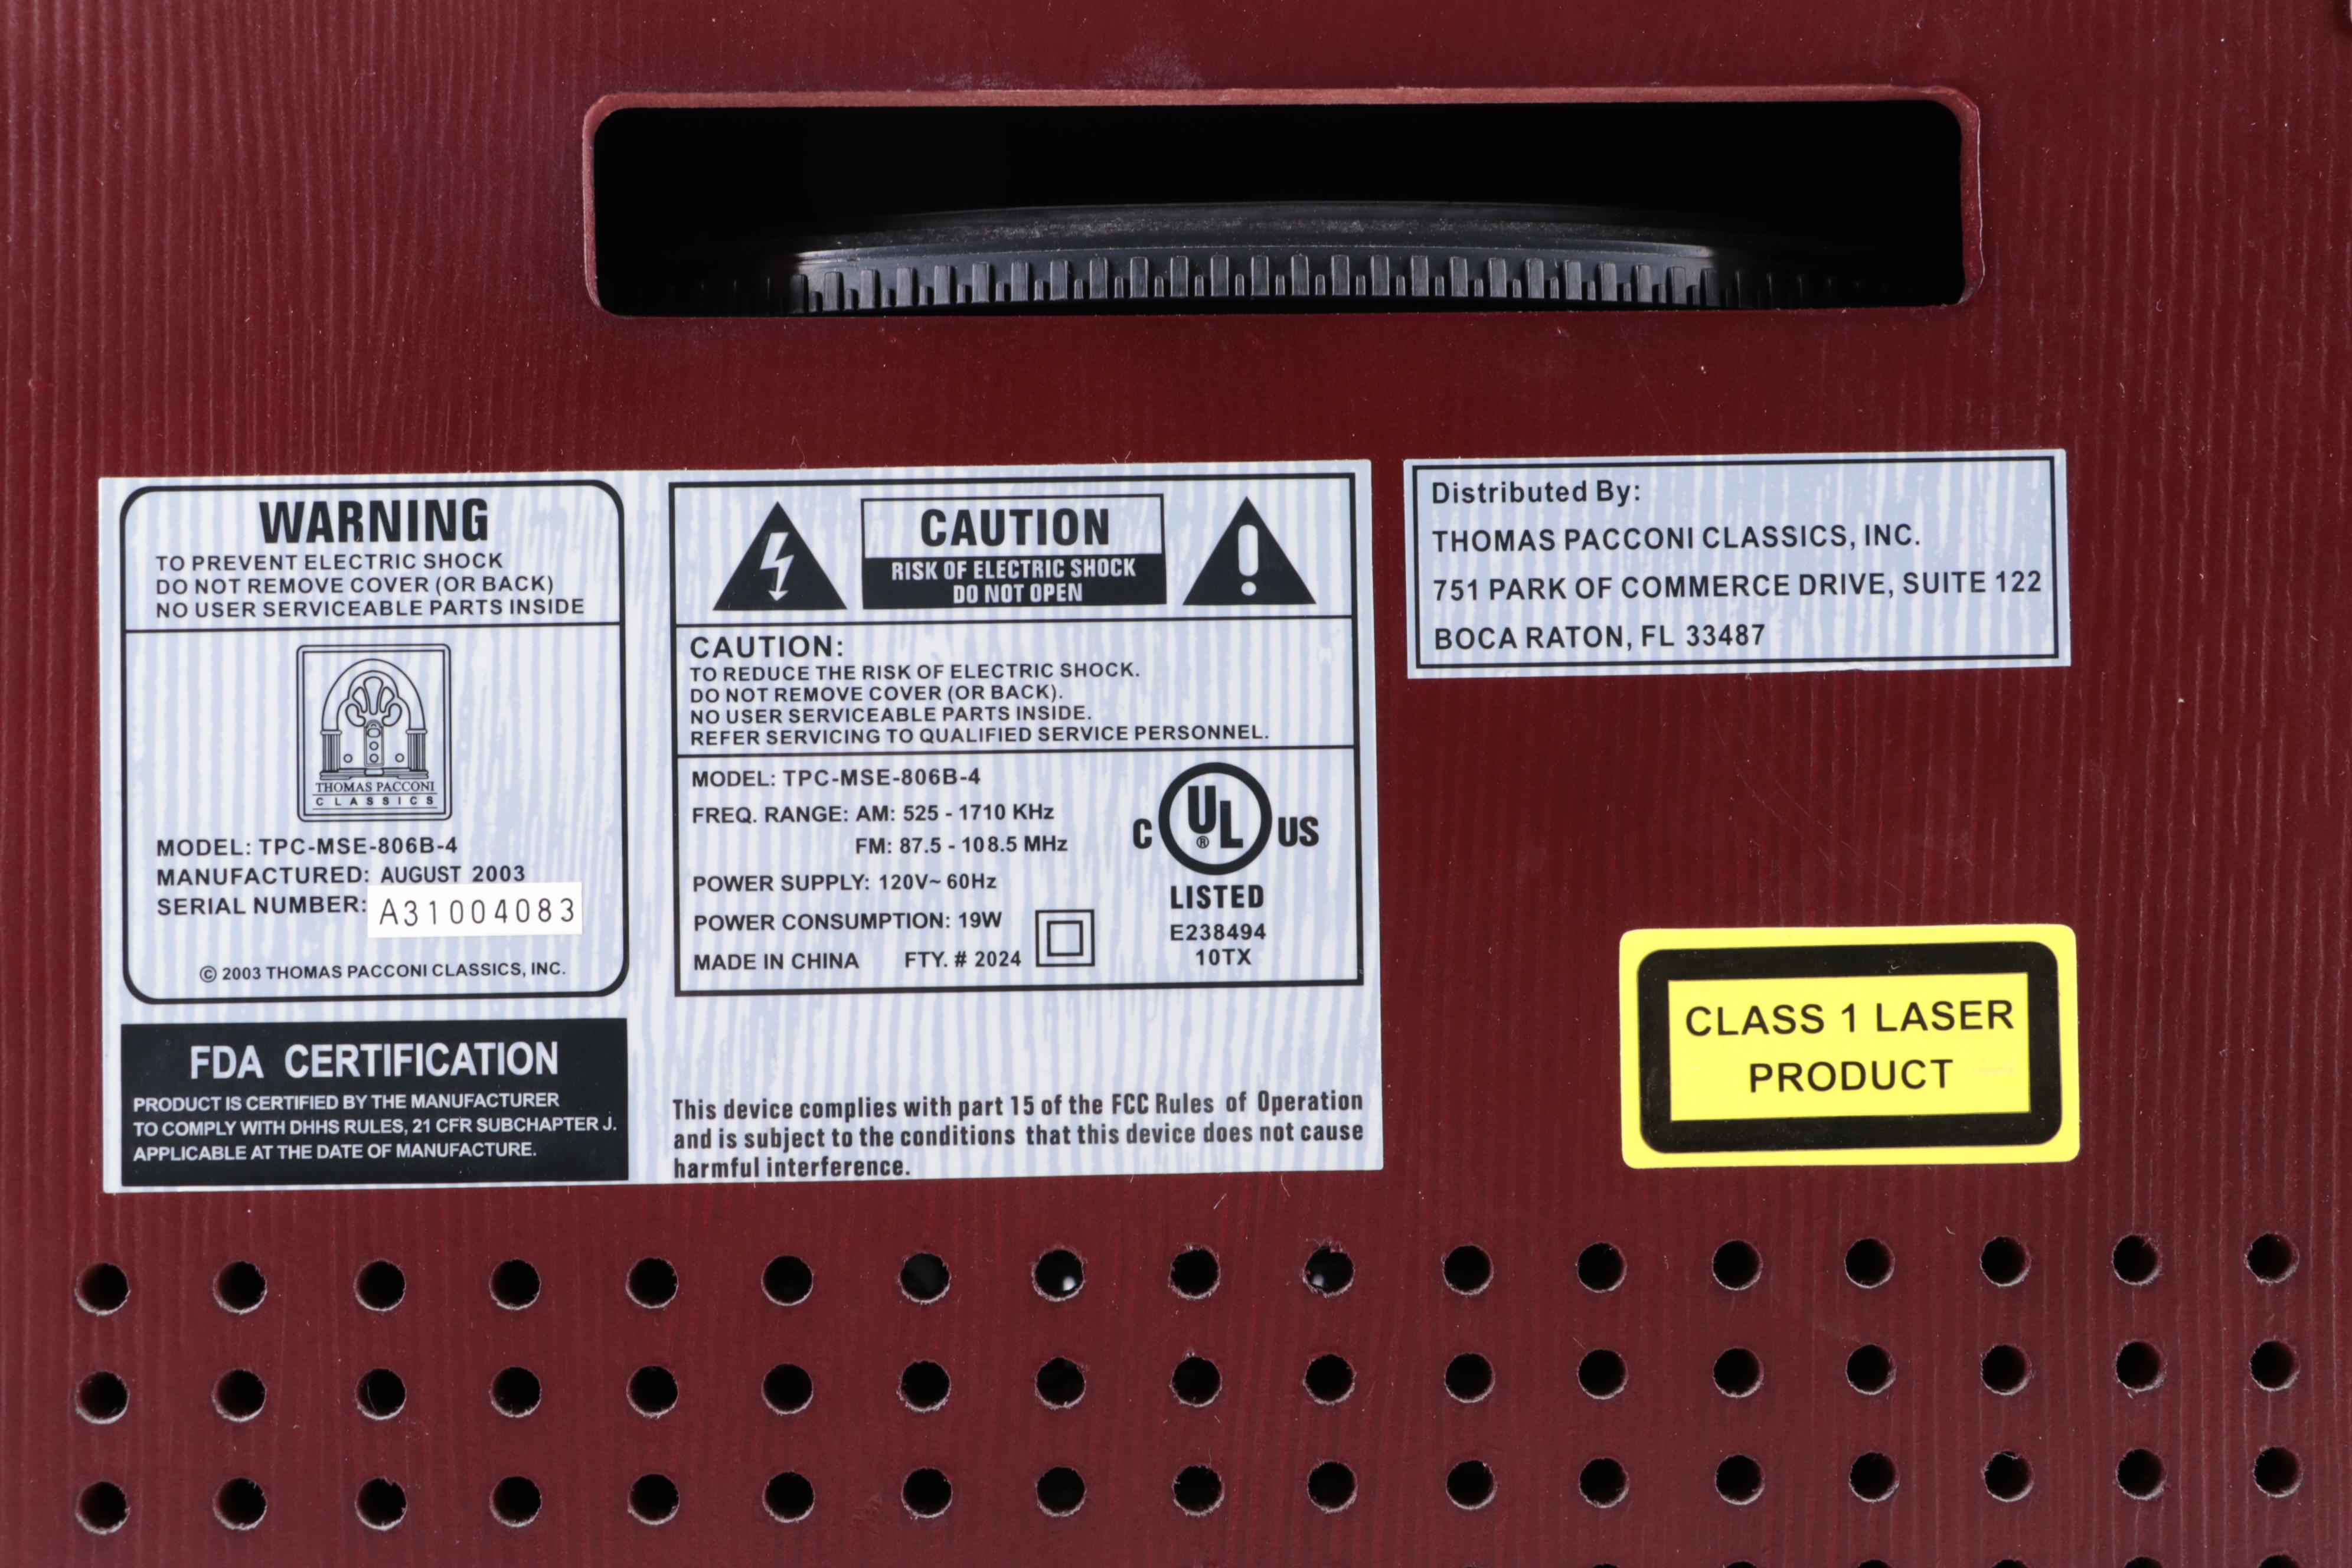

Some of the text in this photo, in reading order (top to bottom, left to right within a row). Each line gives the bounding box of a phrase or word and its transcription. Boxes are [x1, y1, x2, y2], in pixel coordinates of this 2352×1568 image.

[1432, 479, 1639, 508] Distributed By:
[259, 498, 488, 544] WARNING
[921, 508, 1109, 547] CAUTION
[1432, 523, 1920, 553] THOMAS PACCONI CLASSICS, INC.
[155, 553, 503, 571] TO PREVENT ELECTRIC SHOCK
[892, 558, 1136, 580] RISK OF ELECTRIC SHOCK
[156, 576, 553, 596] DO NOT REMOVE COVER (OR BACK)
[953, 583, 1082, 604] DO NOT OPEN
[1433, 570, 2041, 602] 751 PARK OF COMMERCE DRIVE, SUITE 122
[156, 598, 584, 618] NO USER SERVICEABLE PARTS INSIDE
[690, 635, 842, 659] CAUTION:
[1435, 623, 1765, 651] BOCA RATON, FL 33487
[690, 662, 1139, 682] TO REDUCE THE RISK OF ELECTRIC SHOCK.
[691, 724, 1269, 746] REFER SERVICING QUALIFIED SERVICE PERSONNEL.
[315, 782, 436, 793] THOMAS PACCONI
[692, 767, 981, 788] MODEL: TPC-MSE-806B-4
[316, 796, 434, 806] CLASSICS
[692, 803, 1054, 824] FREQ. RANGE: AM: 525 1710 KHz
[1278, 816, 1319, 847] US
[157, 836, 458, 857] MODEL: TPC-MSE-806B-4
[855, 835, 1068, 854] FM: 87.5 108.5 MHz
[157, 865, 525, 886] MANUFACTURED: AUGUST 2003
[693, 873, 997, 892] POWER SUPPLY: 60Hz
[158, 896, 366, 916] SERIAL NUMBER:
[1171, 884, 1264, 910] LISTED
[380, 897, 574, 927] A31004083
[694, 911, 1002, 932] POWER CONSUMPTION: 19W
[1170, 923, 1266, 941] E238494
[694, 952, 860, 971] MADE IN CHINA
[905, 950, 1021, 968] FTY. 2024
[1195, 948, 1252, 966] 10TX
[223, 962, 566, 981] 2003 THOMAS PACCONI CLASSICS, INC.
[1685, 999, 2014, 1037] CLASS 1 LASER
[191, 1041, 558, 1079] FDA CERTIFICATION
[1750, 1059, 1954, 1093] PRODUCT
[133, 1092, 560, 1112] PRODUCT IS CERTIFIED BY THE MANUFACTURER
[672, 1089, 1363, 1123] This device complies with part 15 of the FCC Rules of Operation
[133, 1116, 617, 1137] TO COMPLY WITH DHHS RULES, 21 CFR SUBCHAPTER J.
[674, 1121, 1363, 1154] and is subject to the conditions that this device does not cause
[133, 1142, 537, 1161] APPLICABLE THE DATE OF MANUFACTURE.
[674, 1155, 910, 1179] harmful interference.
